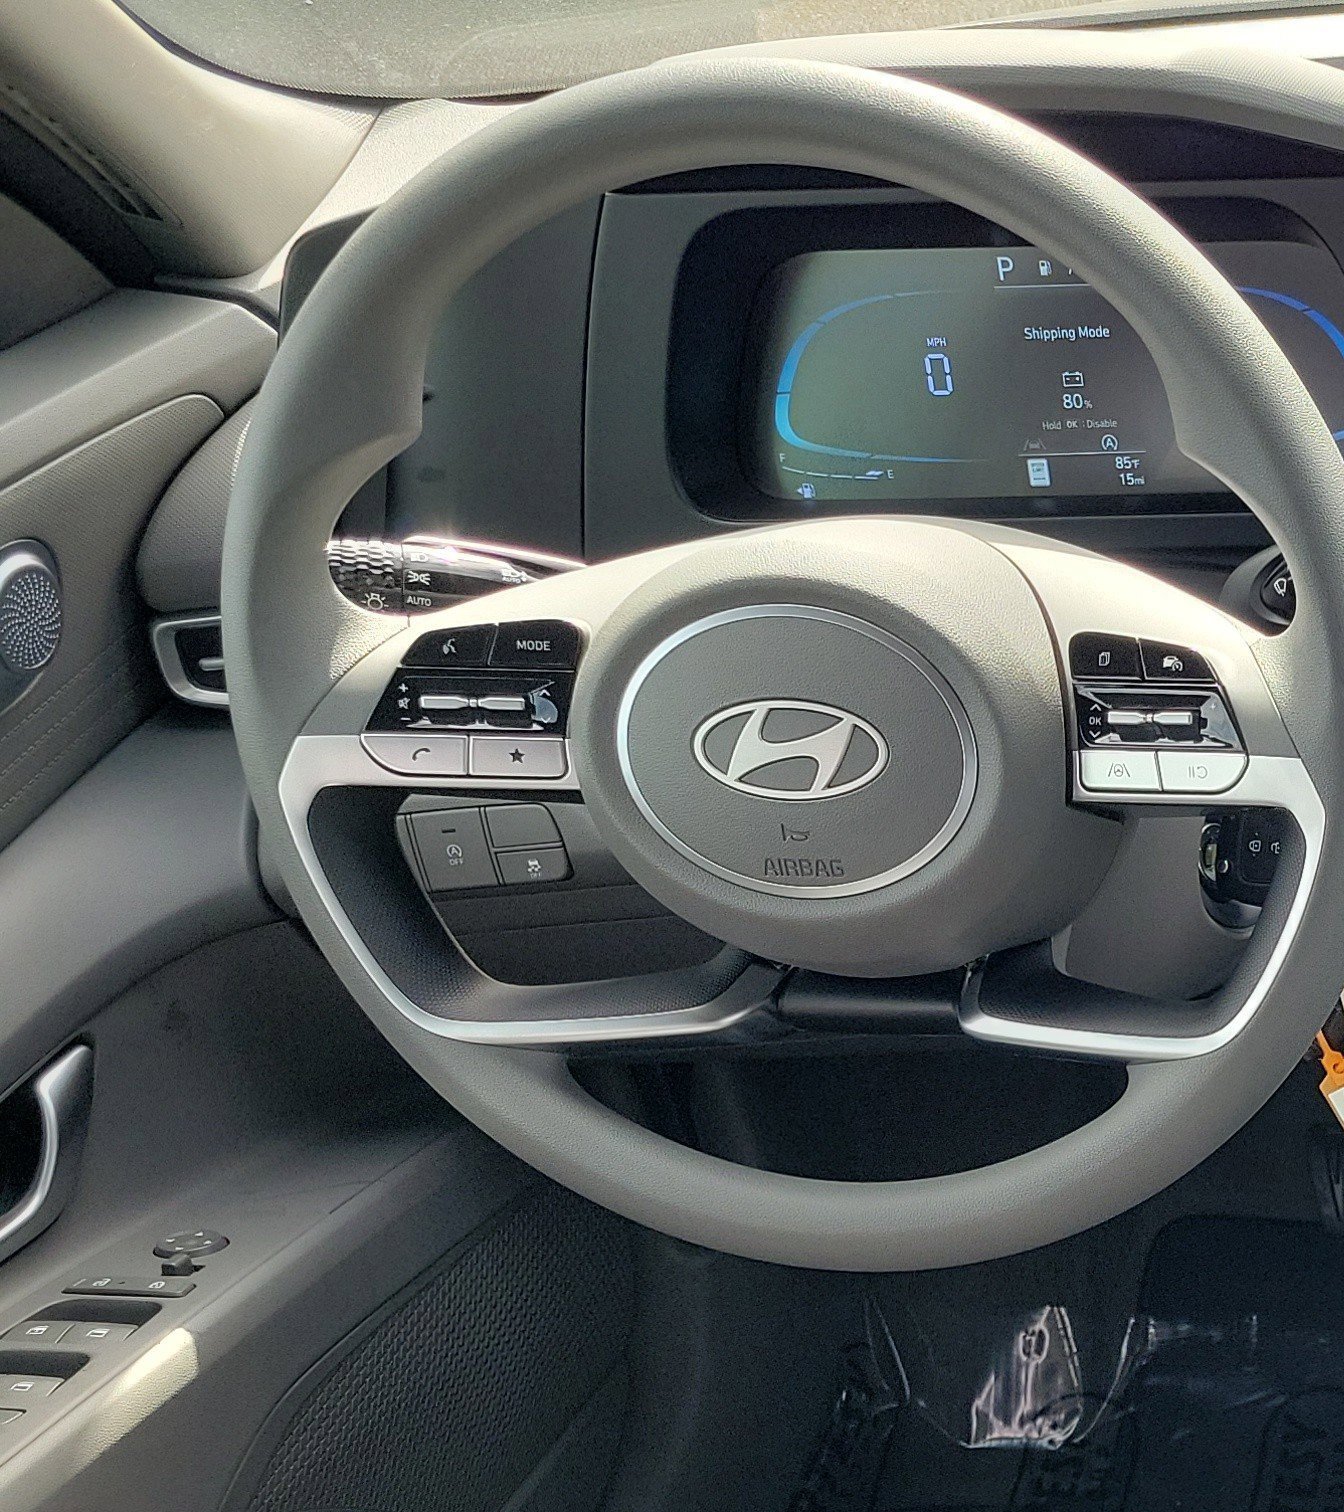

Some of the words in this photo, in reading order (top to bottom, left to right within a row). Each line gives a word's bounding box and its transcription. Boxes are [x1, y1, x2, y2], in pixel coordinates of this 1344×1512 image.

[996, 256, 1014, 282] P
[1024, 326, 1076, 342] Shipping
[1078, 325, 1110, 339] Mode
[926, 337, 947, 347] MPH
[924, 353, 954, 396] 0
[1042, 420, 1062, 430] Hold
[1066, 420, 1078, 428] OK
[779, 453, 786, 463] F
[887, 469, 894, 479] E
[406, 595, 432, 608] AUTO
[517, 639, 551, 652] MODE
[1089, 716, 1102, 726] OK
[763, 857, 845, 878] AIRBAG
